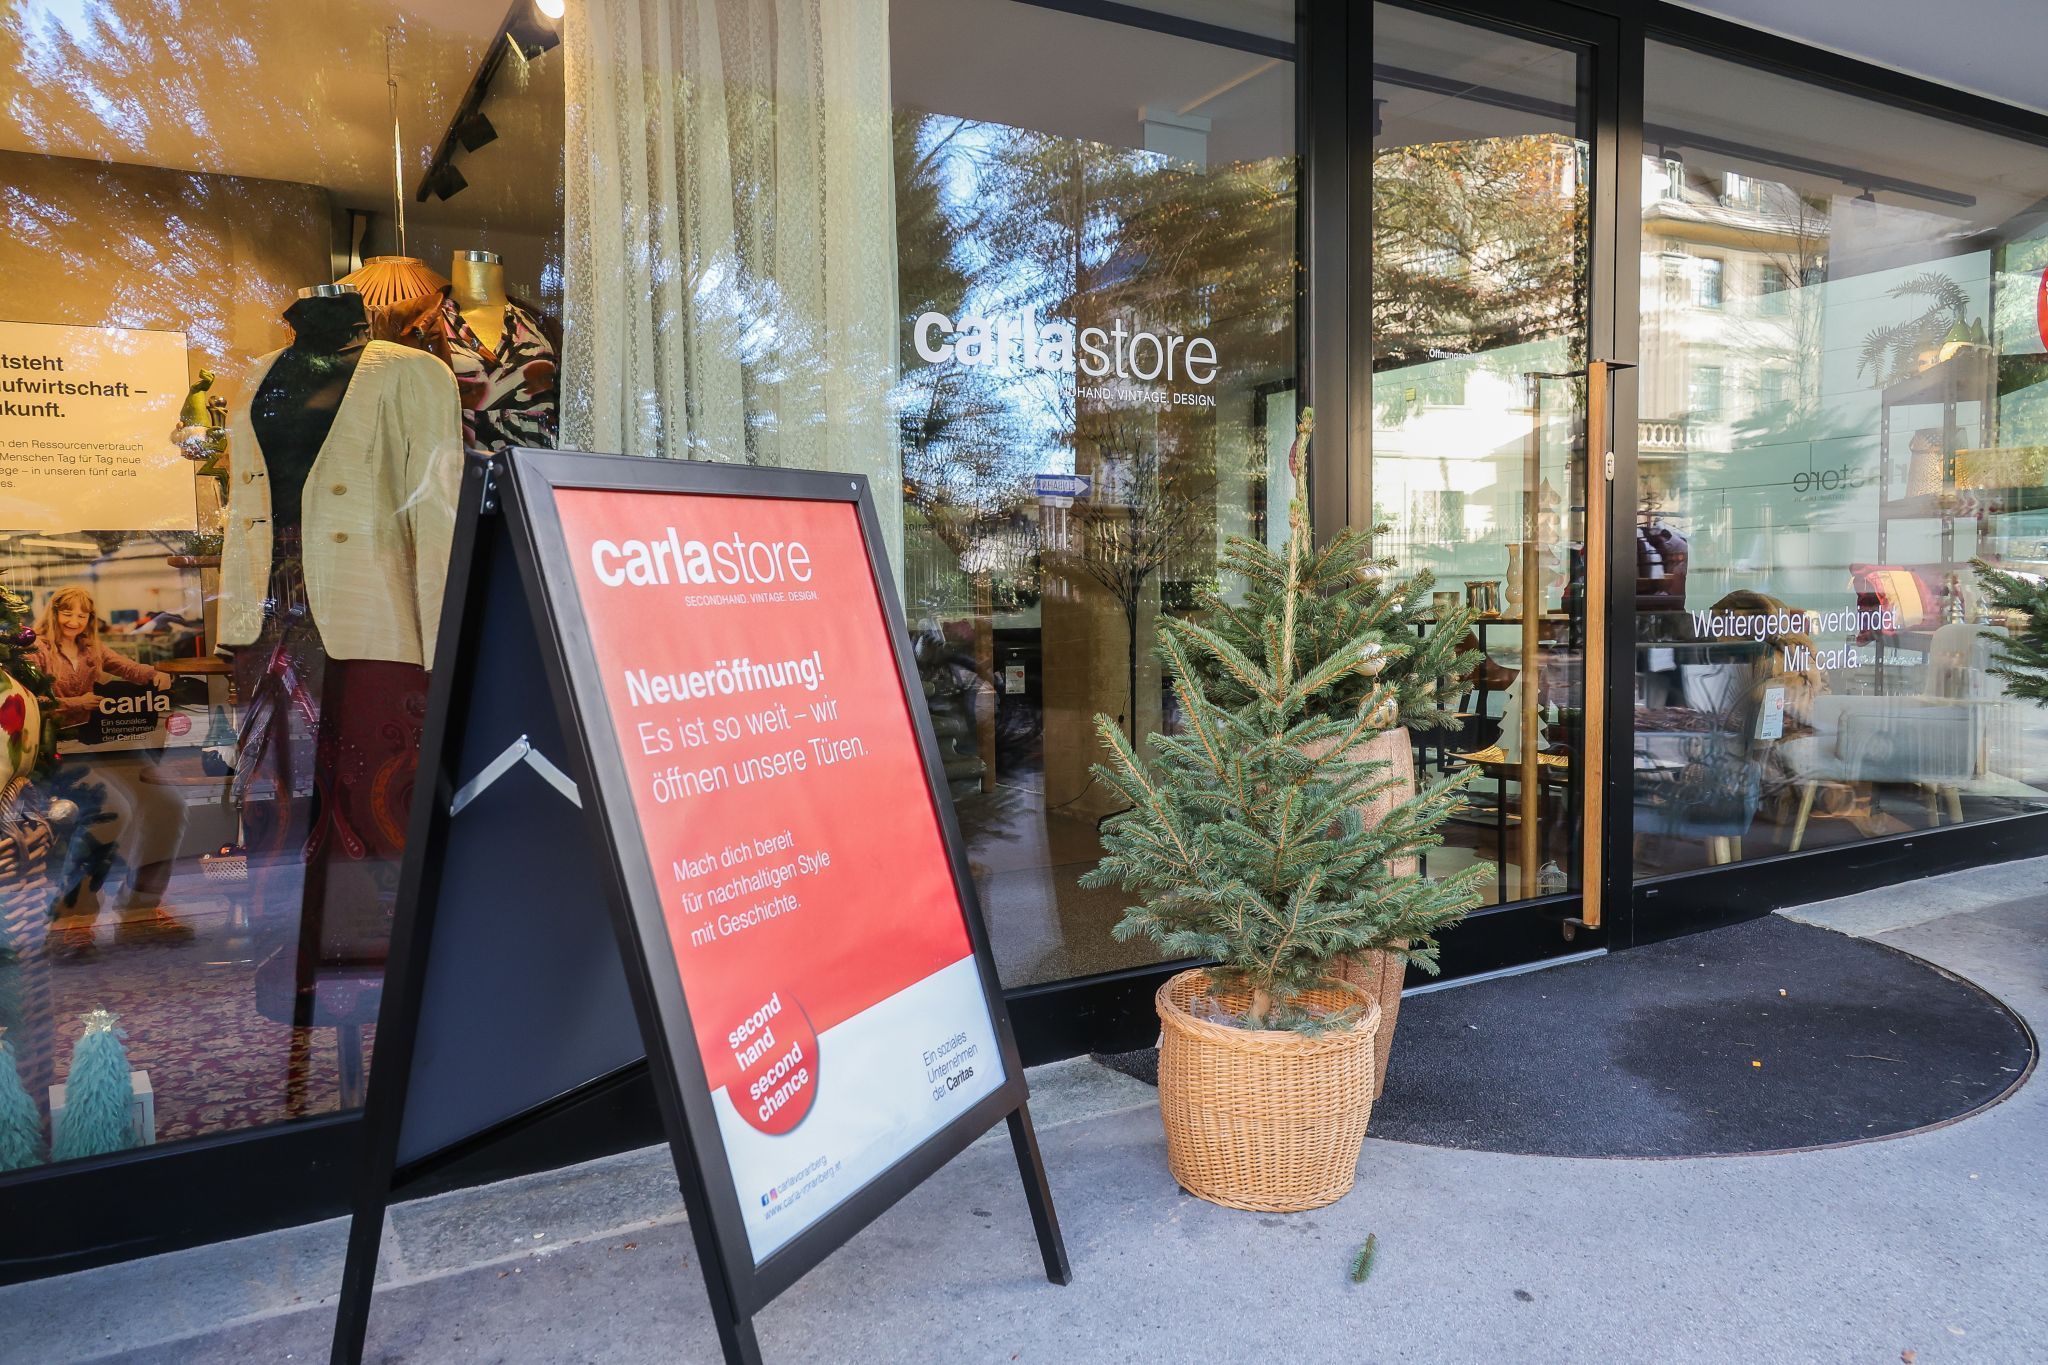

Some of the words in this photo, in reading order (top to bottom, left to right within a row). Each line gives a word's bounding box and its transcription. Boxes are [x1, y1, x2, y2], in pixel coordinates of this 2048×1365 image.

[1, 353, 63, 371] tsteht
[913, 305, 1218, 384] carlastore
[0, 378, 129, 397] ufwirtschaft
[1117, 390, 1169, 403] VINTAGE.
[1173, 393, 1216, 406] DESIGN.
[0, 400, 65, 418] kunft.
[0, 452, 55, 462] Menschen
[57, 453, 76, 465] Tag
[79, 453, 92, 463] für
[95, 455, 114, 466] Tag
[8, 439, 29, 449] den
[31, 439, 144, 452] Ressourcenverbrauch
[31, 466, 41, 475] in
[44, 467, 86, 476] unseren
[89, 467, 108, 476] fünf
[111, 468, 137, 477] carla
[591, 526, 812, 587] carlastore
[685, 593, 749, 607] SECONDHAND.
[1691, 607, 1812, 642] Weitergeben
[1818, 605, 1900, 633] verbindet.
[1783, 645, 1811, 672] Mit
[1815, 643, 1862, 670] carla.
[624, 651, 826, 707] Neueröffnung!
[99, 690, 171, 715] carla
[101, 719, 114, 727] Ein
[115, 717, 147, 725] soziales
[637, 721, 674, 756] Es
[677, 717, 709, 748] ist
[712, 716, 742, 742] so
[745, 702, 791, 735] weit
[810, 694, 839, 723] wir
[652, 766, 729, 804] öffnen
[733, 749, 807, 785] unsere
[808, 735, 869, 767] Türen.
[673, 852, 718, 882] Mach
[720, 842, 752, 868] dich
[753, 829, 795, 857] bereit
[681, 891, 703, 915] für
[707, 862, 797, 906] nachhaltigen
[797, 850, 831, 876] Style
[691, 921, 717, 947] mit
[717, 894, 801, 936] Geschichte.
[728, 991, 782, 1049] second
[735, 1026, 776, 1072] hand
[922, 1050, 938, 1067] Ein
[937, 1031, 967, 1058] soziales
[927, 1044, 979, 1083] Unternehmen
[750, 1041, 803, 1101] second
[932, 1084, 946, 1101] der
[946, 1066, 974, 1091] Caritas
[758, 1067, 809, 1122] chance
